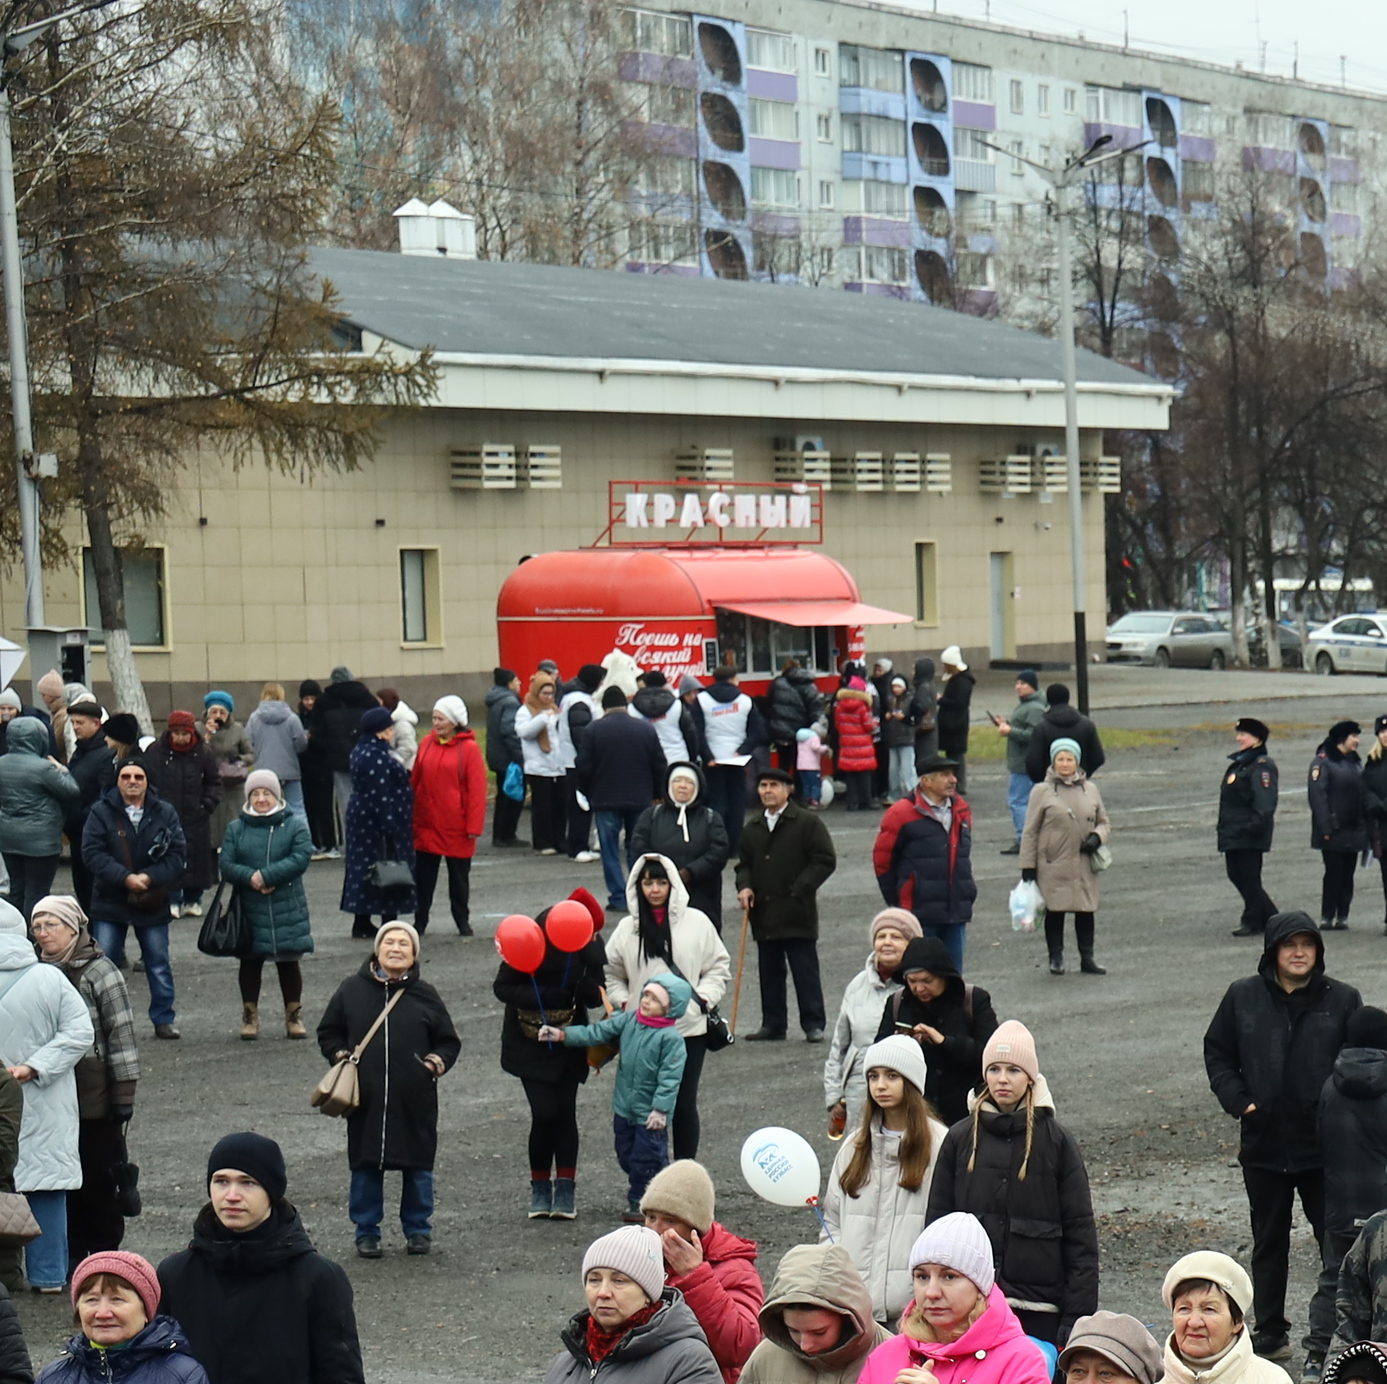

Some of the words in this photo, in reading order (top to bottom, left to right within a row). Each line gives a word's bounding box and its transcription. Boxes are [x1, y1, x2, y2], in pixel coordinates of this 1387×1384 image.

[624, 483, 812, 529] КРАСНЫЙ
[615, 623, 680, 646] Поешь
[682, 632, 702, 646] на
[633, 645, 692, 665] всякий
